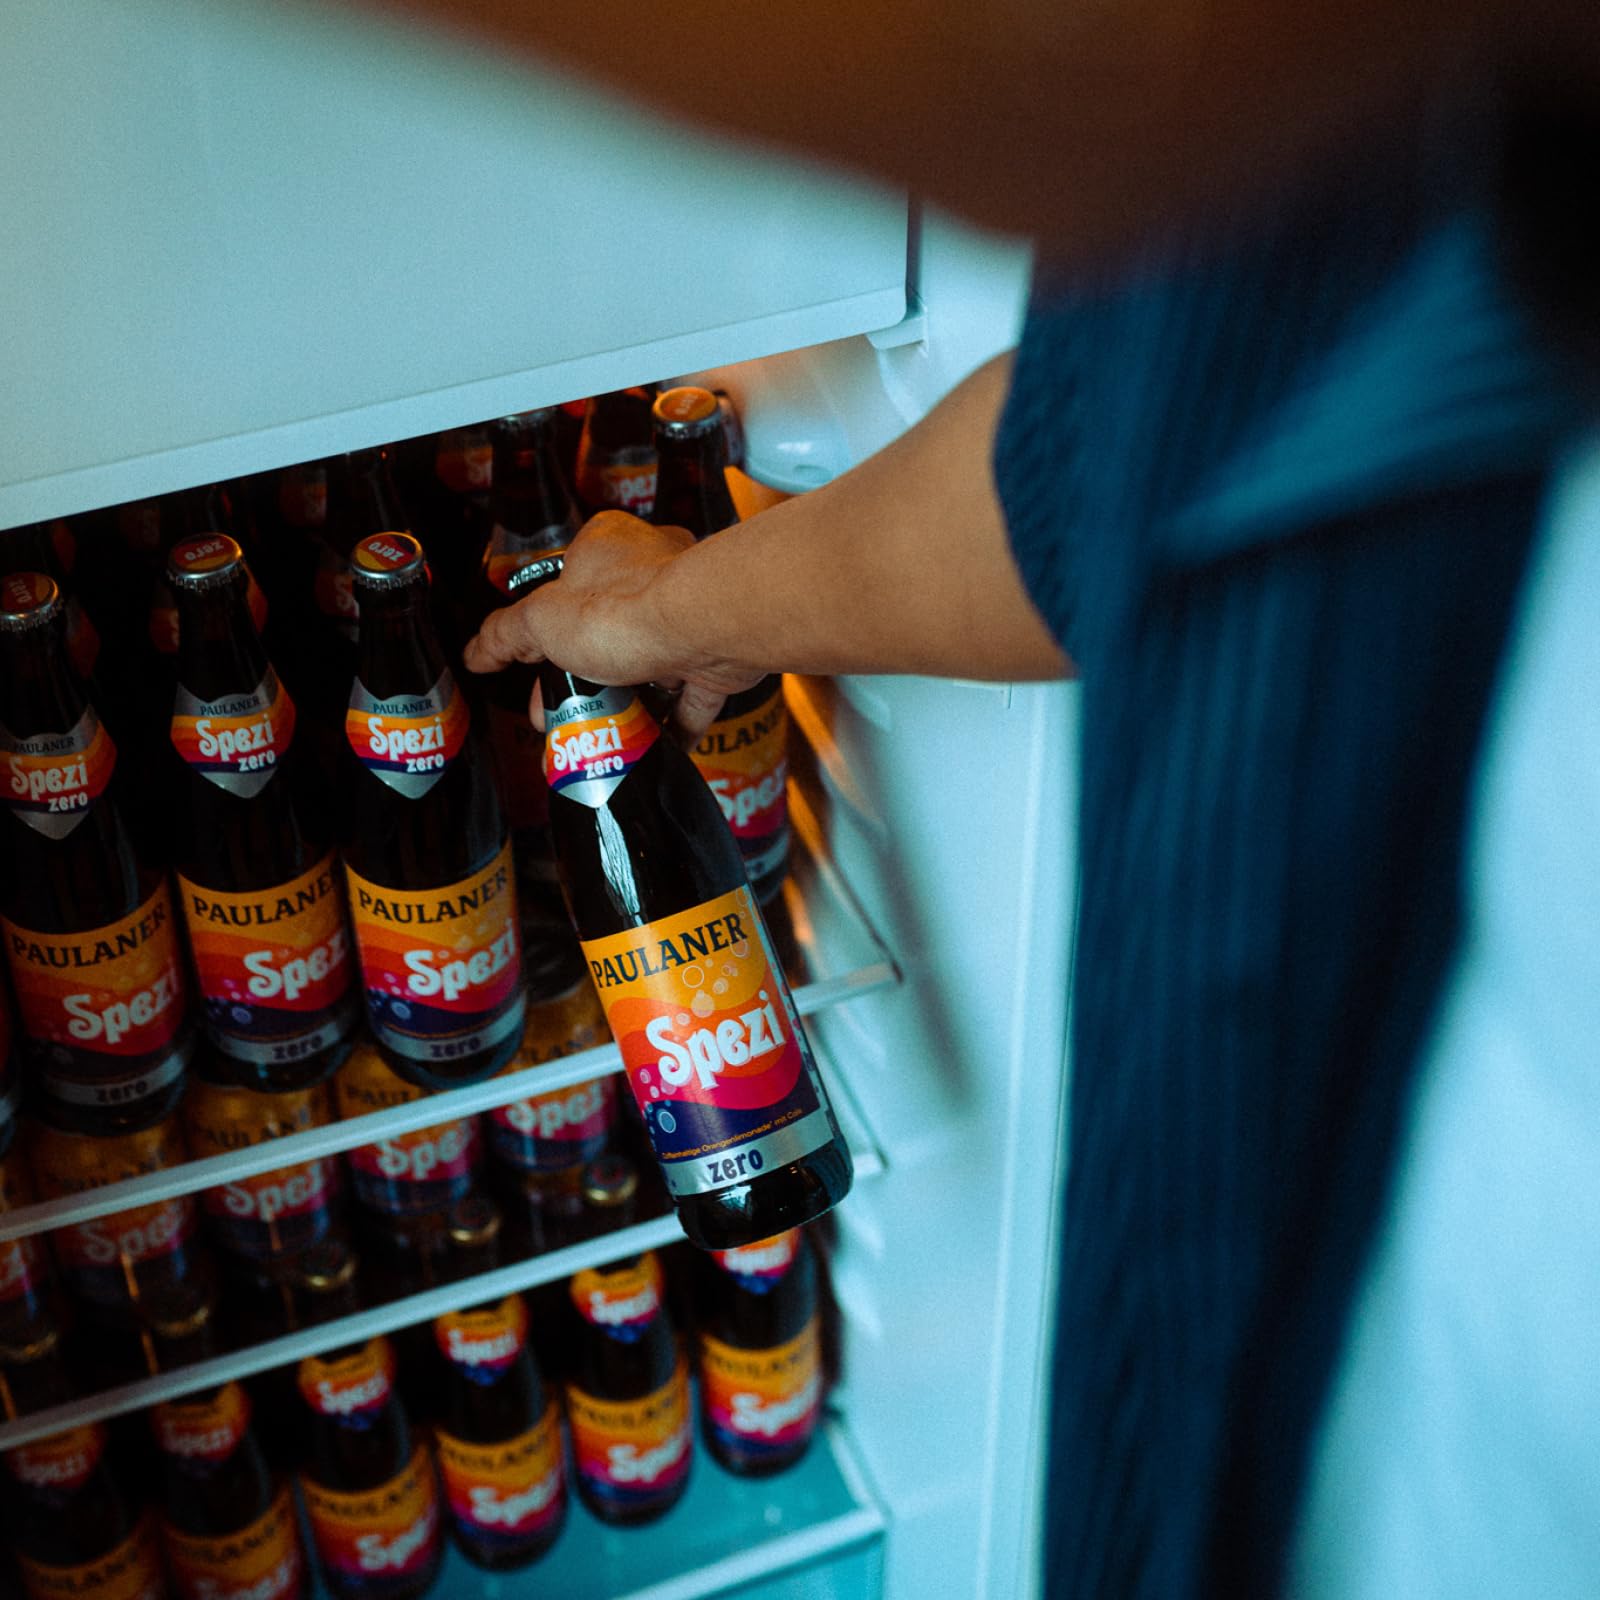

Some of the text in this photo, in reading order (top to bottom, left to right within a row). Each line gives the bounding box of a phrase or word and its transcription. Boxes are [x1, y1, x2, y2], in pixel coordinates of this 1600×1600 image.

[368, 541, 405, 561] zero
[200, 696, 261, 716] PAULANER
[373, 698, 433, 715] PAULANER
[550, 700, 605, 727] PAULANER
[196, 713, 275, 761] Spezi
[368, 717, 446, 761] Spezi
[550, 718, 624, 772] Spezi
[238, 750, 276, 772] zero
[406, 754, 445, 773] zero
[584, 755, 624, 779] zero
[10, 754, 89, 800] Spezi
[48, 792, 88, 812] zero
[193, 872, 332, 926] PAULANE
[403, 917, 516, 1001] Spezi
[591, 911, 748, 989] PAULANER
[243, 927, 346, 1001] Spez
[273, 1035, 323, 1060] zero
[430, 1037, 481, 1058] zero
[646, 989, 787, 1091] Spezi
[95, 1080, 147, 1102] zero
[708, 1149, 763, 1183] zero
